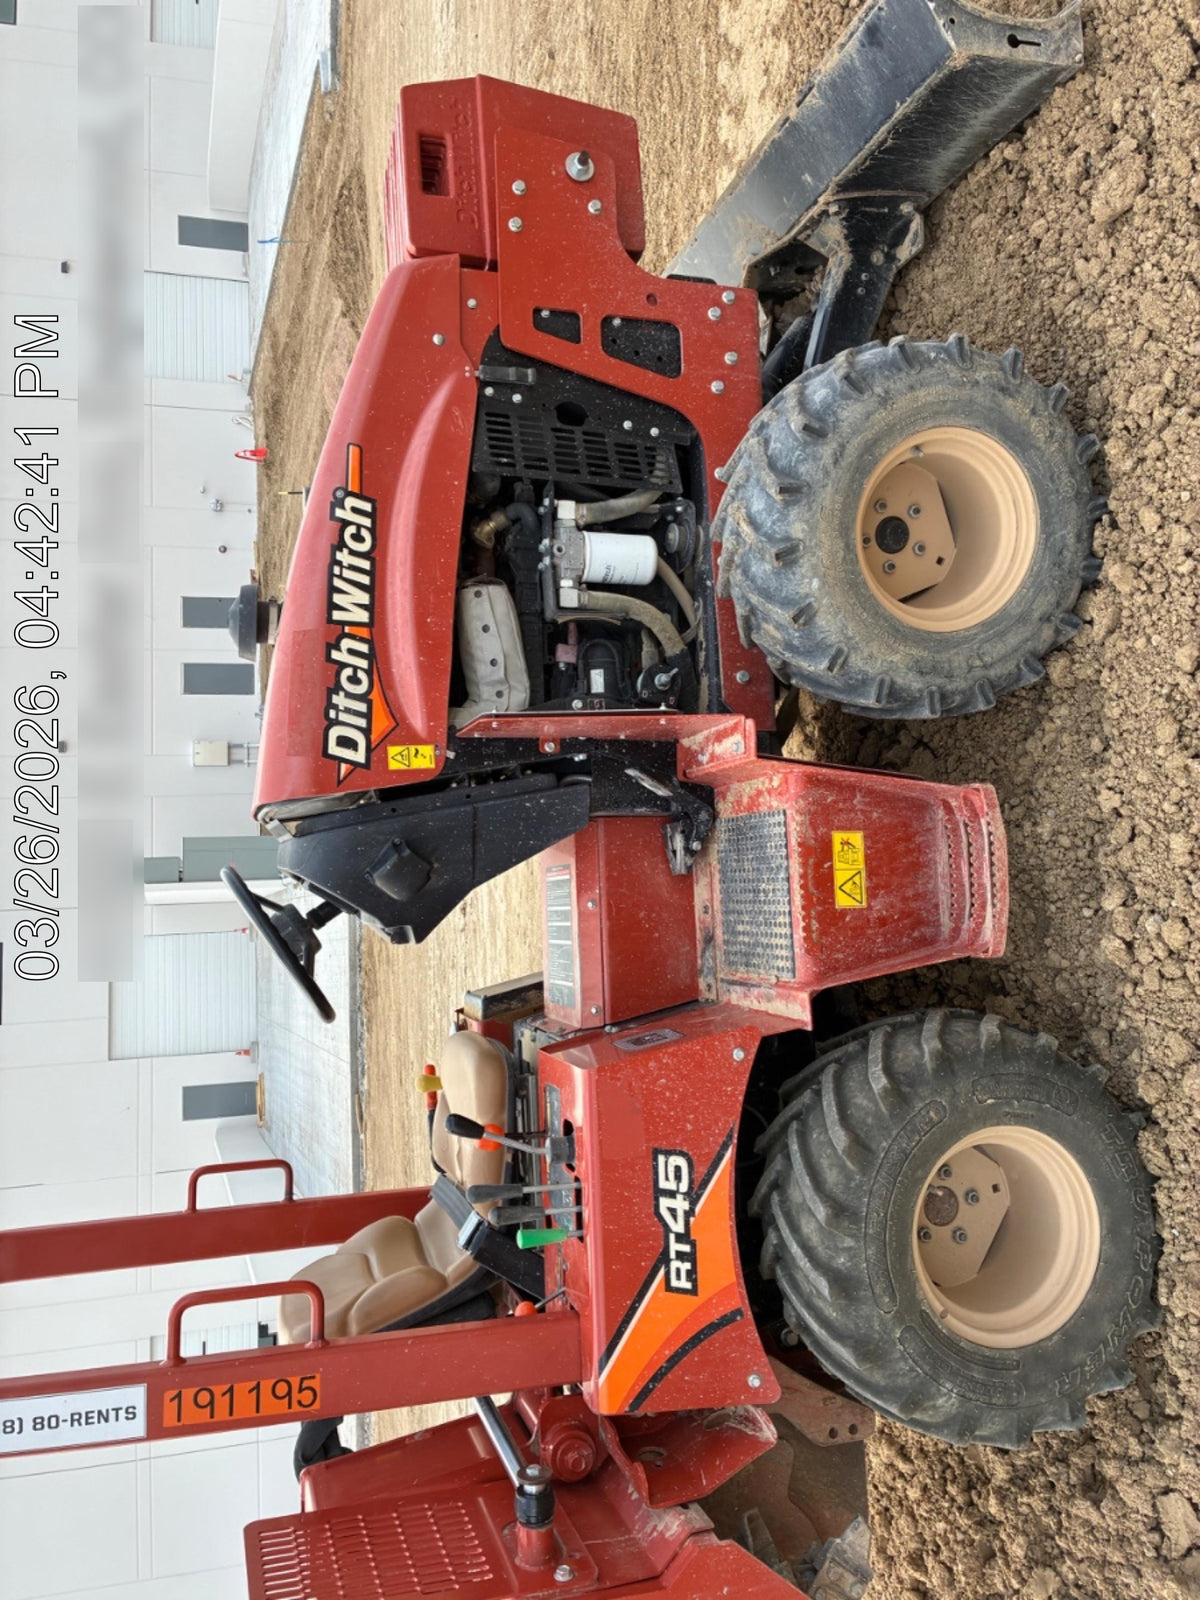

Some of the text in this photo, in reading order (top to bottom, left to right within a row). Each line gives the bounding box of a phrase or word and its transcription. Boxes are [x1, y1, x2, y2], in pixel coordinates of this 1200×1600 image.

[327, 639, 370, 764] Ditch
[657, 1154, 693, 1290] RT45
[32, 1405, 137, 1432] 80-RENTS
[169, 1375, 318, 1423] 191195
